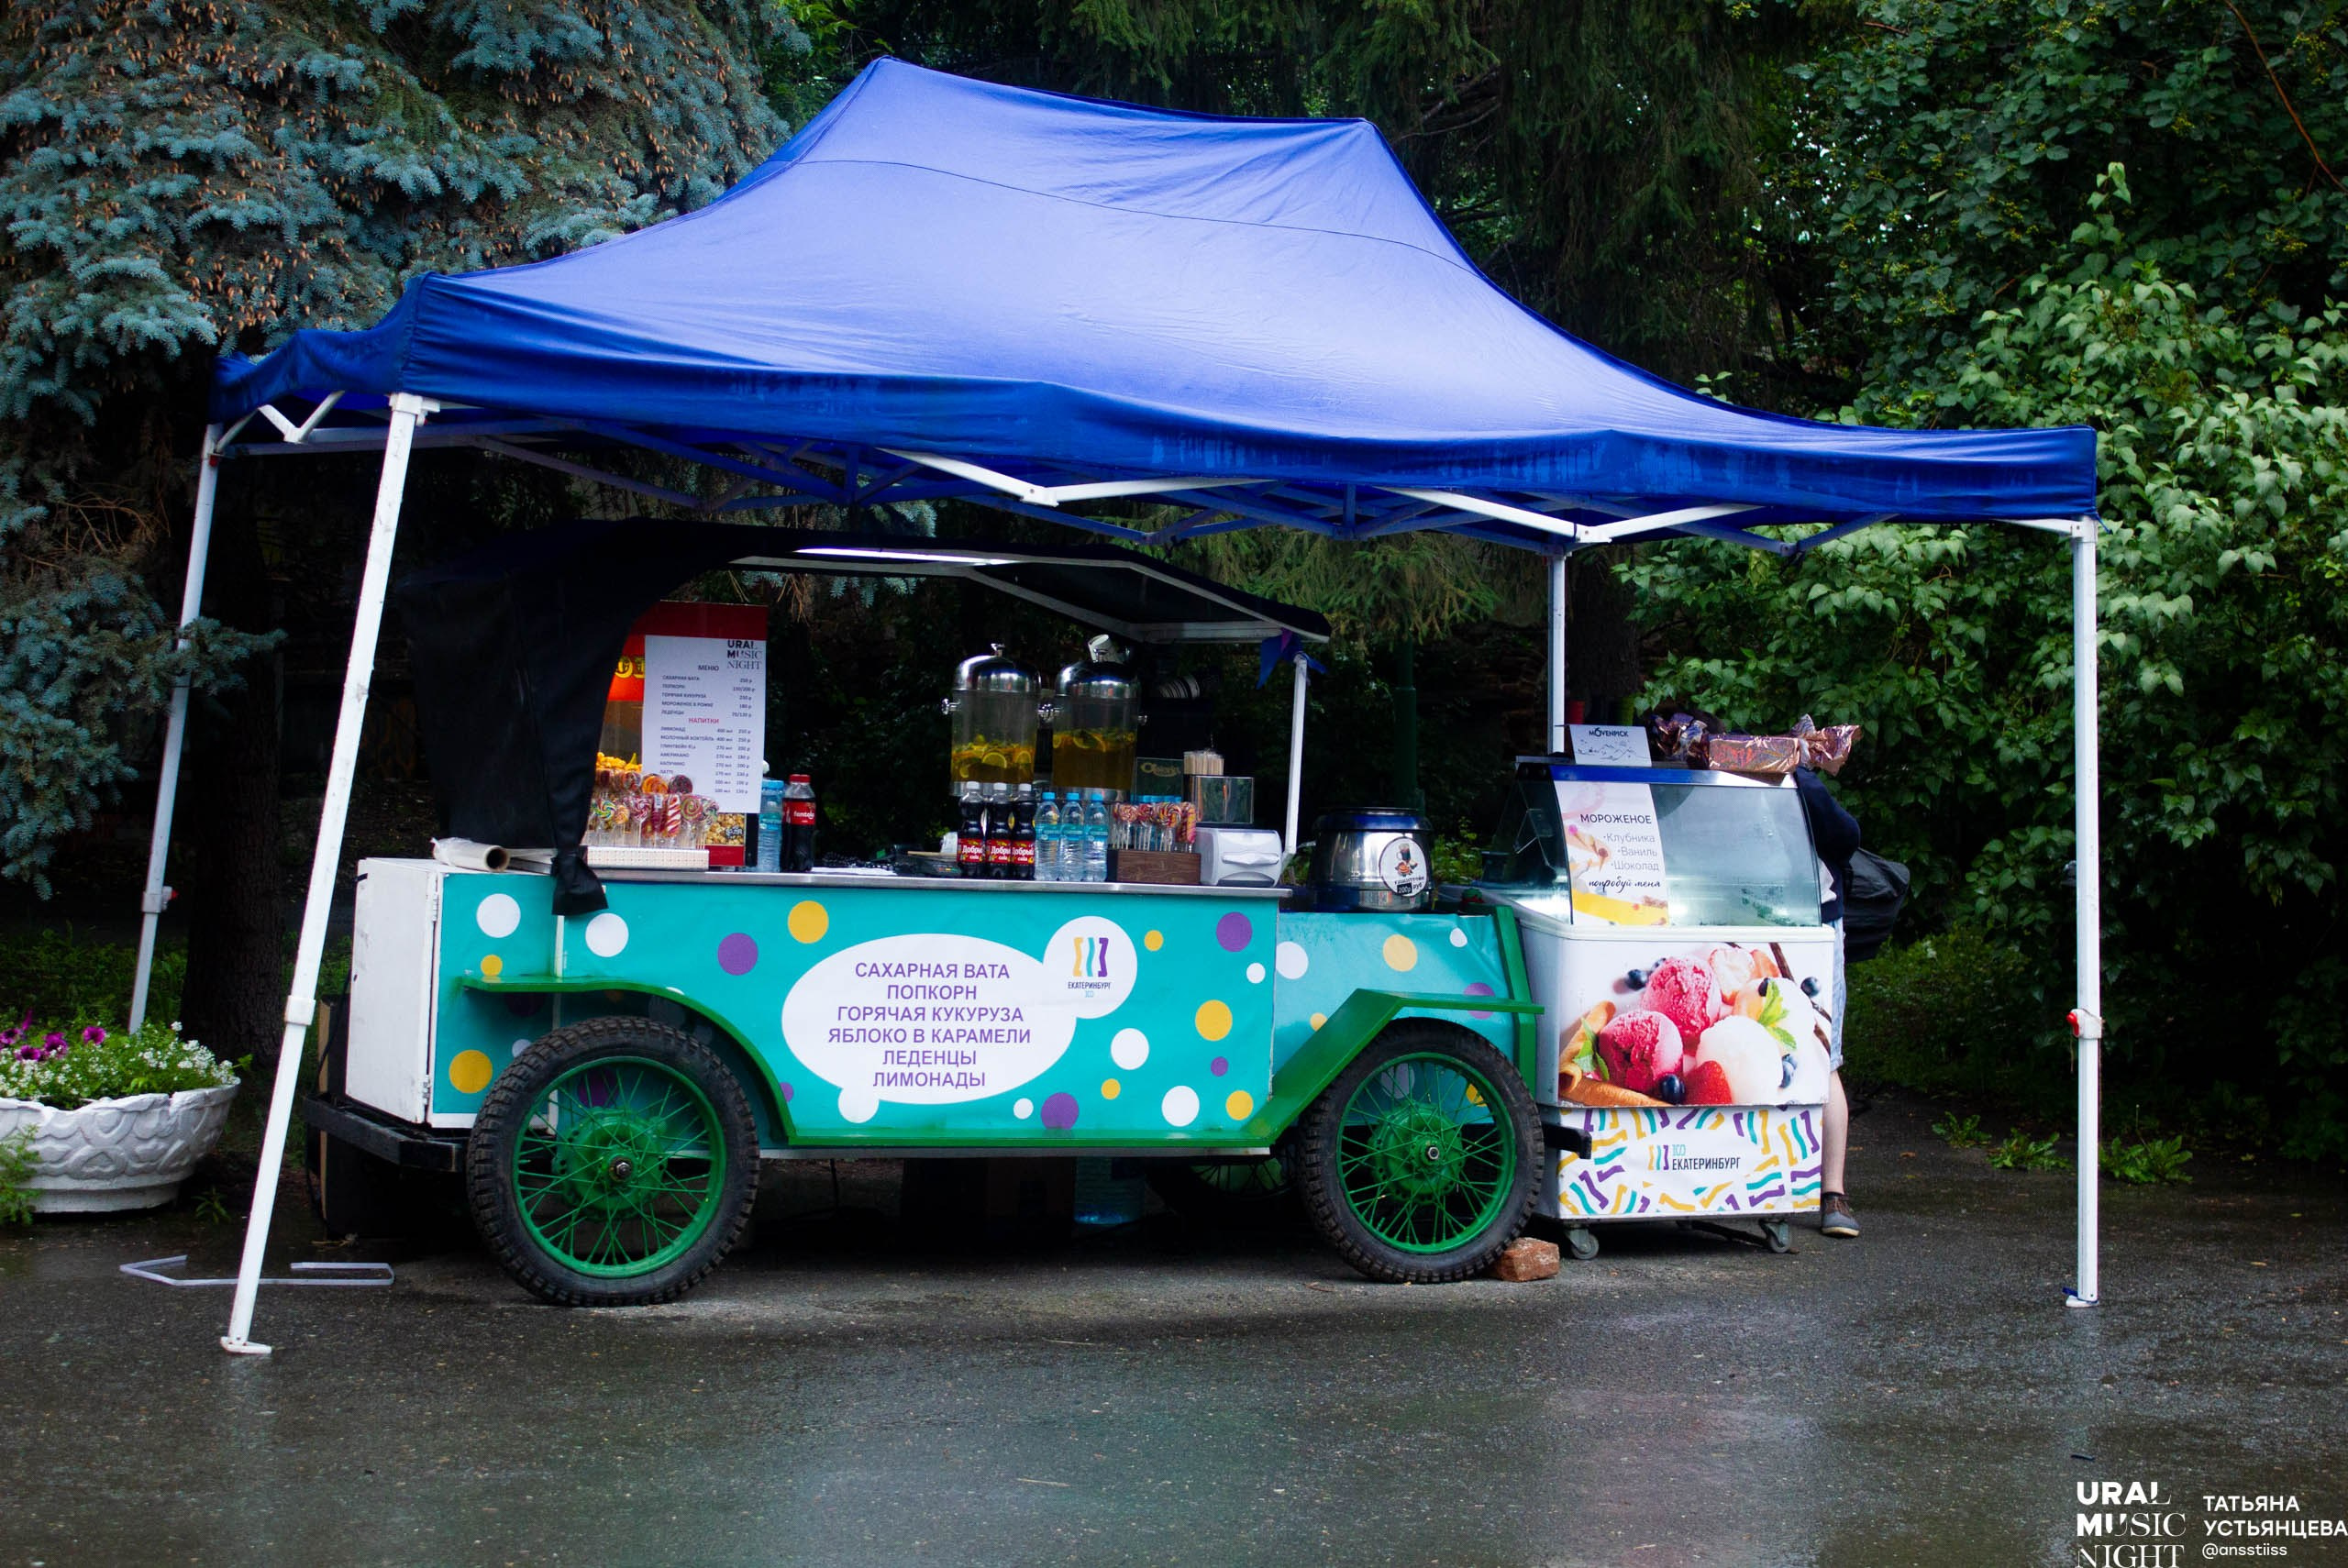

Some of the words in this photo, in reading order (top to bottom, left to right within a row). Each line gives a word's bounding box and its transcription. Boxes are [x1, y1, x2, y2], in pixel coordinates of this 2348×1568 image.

[727, 640, 757, 650] URAL
[726, 650, 762, 660] MUSIC
[726, 660, 762, 670] NIGHT
[1579, 813, 1652, 824] МОРОЖЕНОЕ
[1606, 833, 1656, 845] Клубника
[962, 845, 983, 855] Добры
[991, 845, 1012, 856] Добры
[1621, 846, 1657, 857] Ваниль
[1614, 862, 1659, 871] Шоколад
[855, 962, 958, 978] САХАРНАЯ
[964, 963, 1010, 979] ВАТА
[1068, 981, 1112, 990] ЕКАТЕРИНБУРГ
[887, 984, 977, 1000] ПОПКОРН
[837, 1006, 925, 1021] ГОРЯЧАЯ
[932, 1007, 1024, 1022] КУКУРУЗА
[828, 1028, 907, 1043] ЯБЛОКО
[914, 1028, 925, 1043] В
[931, 1029, 1031, 1043] КАРАМЕЛИ
[882, 1050, 977, 1067] ЛЕДЕНЦЫ
[872, 1072, 986, 1089] ЛИМОНАДЫ
[1672, 1157, 1741, 1171] ЕКАТЕРИНБУРГ
